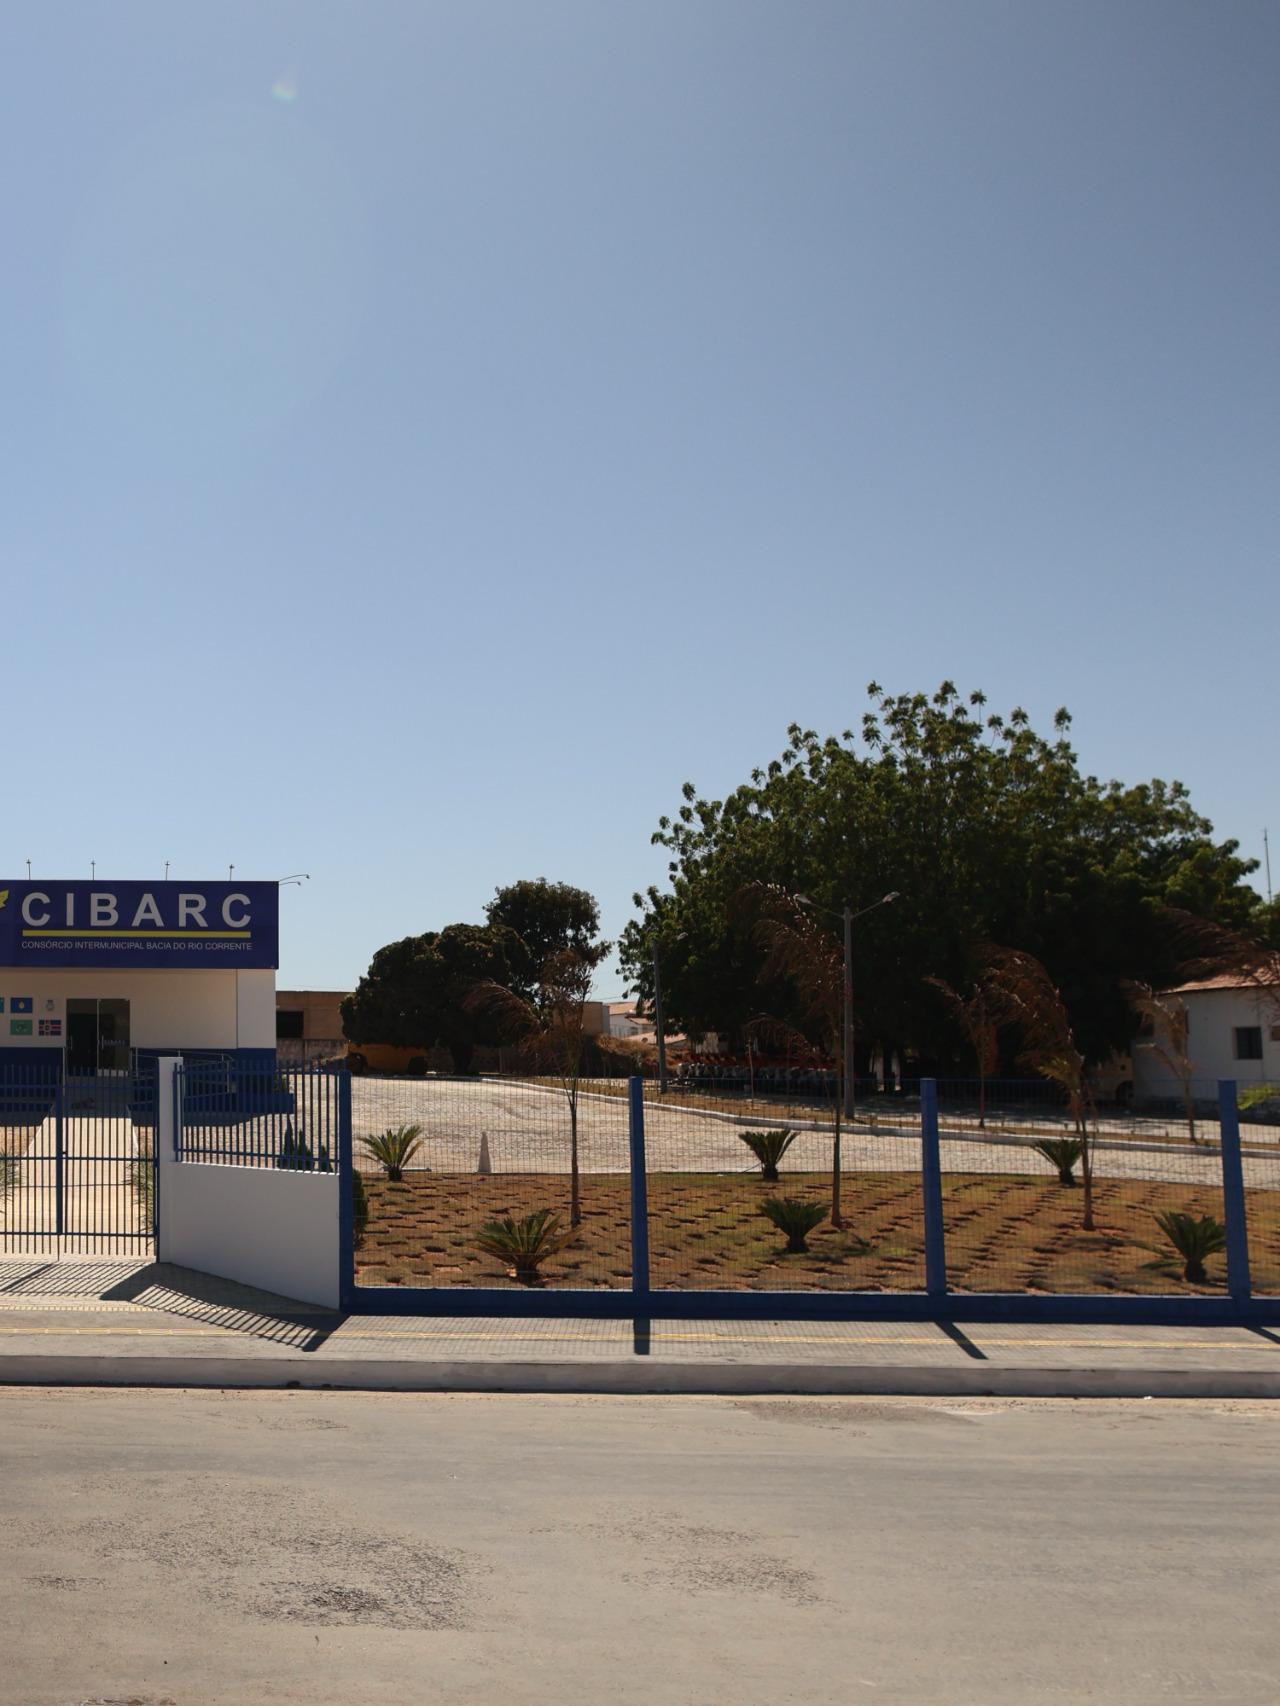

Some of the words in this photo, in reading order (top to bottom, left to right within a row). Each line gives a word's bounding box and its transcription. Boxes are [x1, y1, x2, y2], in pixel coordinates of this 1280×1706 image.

[21, 892, 252, 928] CIBARC
[21, 939, 73, 949] CONSÓRCIO
[74, 941, 145, 950] INTERMUNICIPAL
[146, 942, 171, 950] BACIA
[173, 942, 186, 950] DO
[188, 942, 203, 951] RIO
[205, 942, 253, 951] CORRENTE
